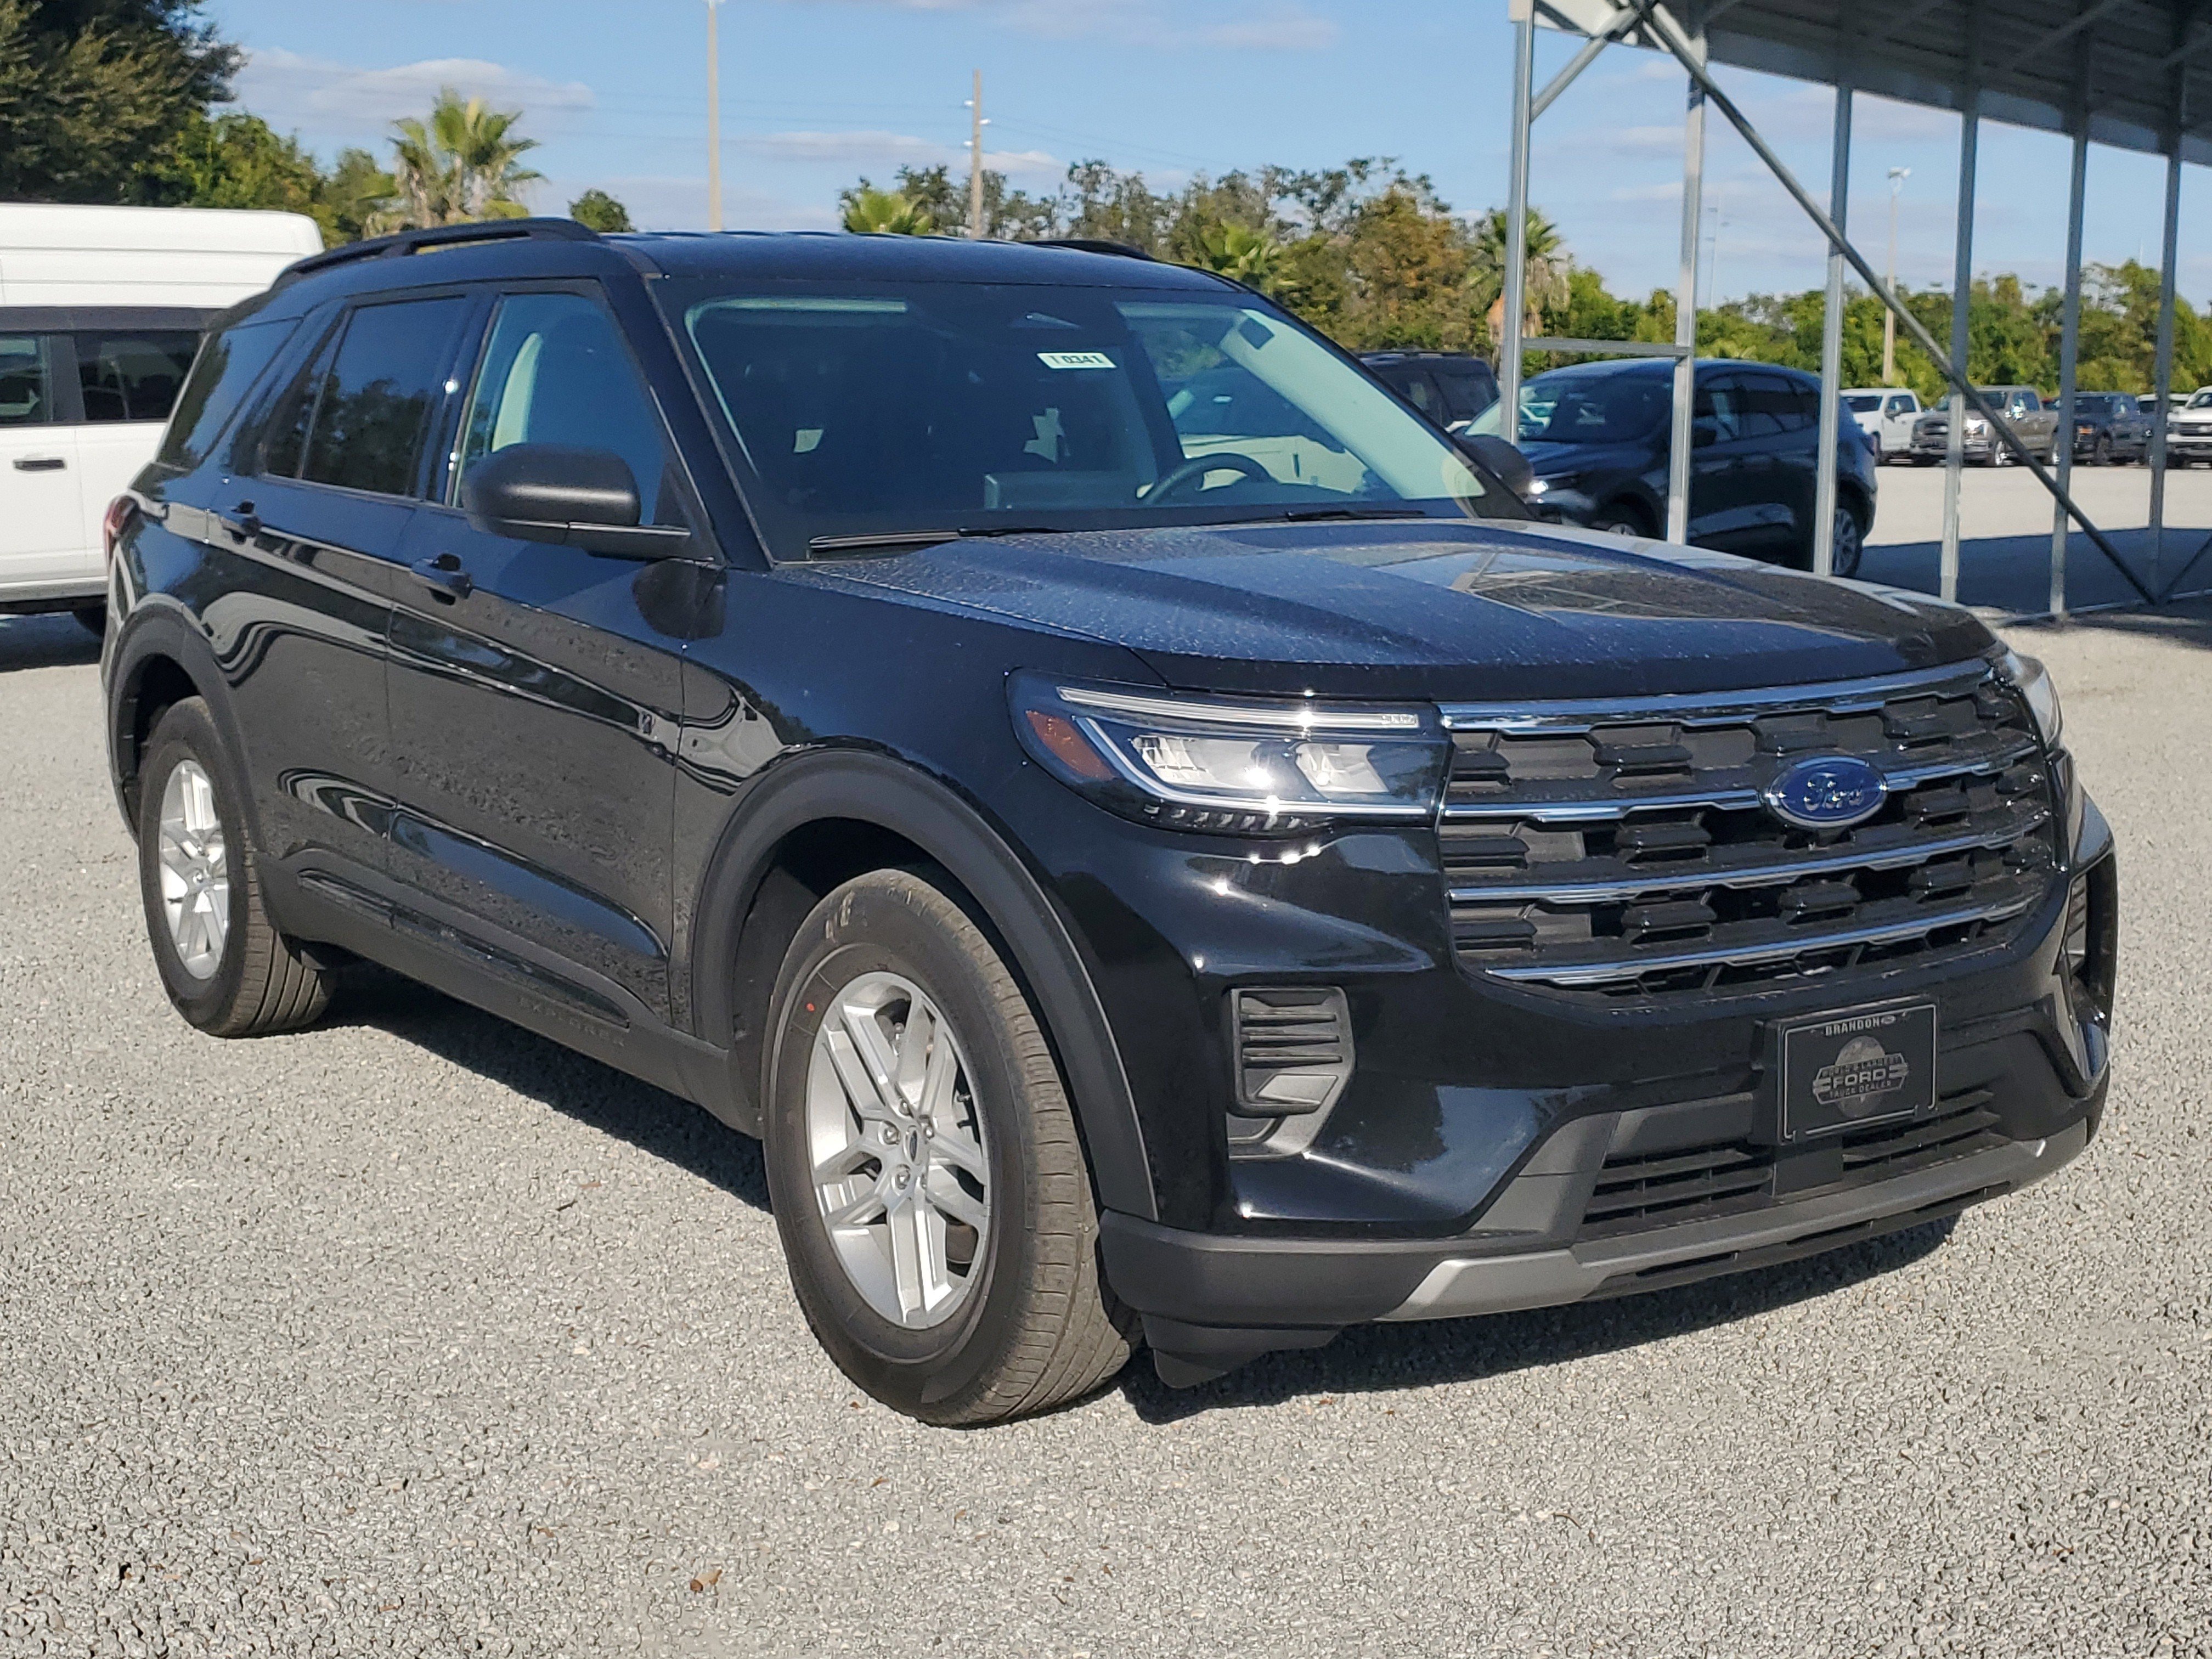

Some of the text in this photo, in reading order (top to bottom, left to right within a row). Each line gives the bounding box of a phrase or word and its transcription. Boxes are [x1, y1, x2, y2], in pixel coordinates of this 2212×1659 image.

[1804, 771, 1864, 811] Ford
[1825, 1017, 1880, 1036] BRANDON
[1833, 1068, 1887, 1090] FORD
